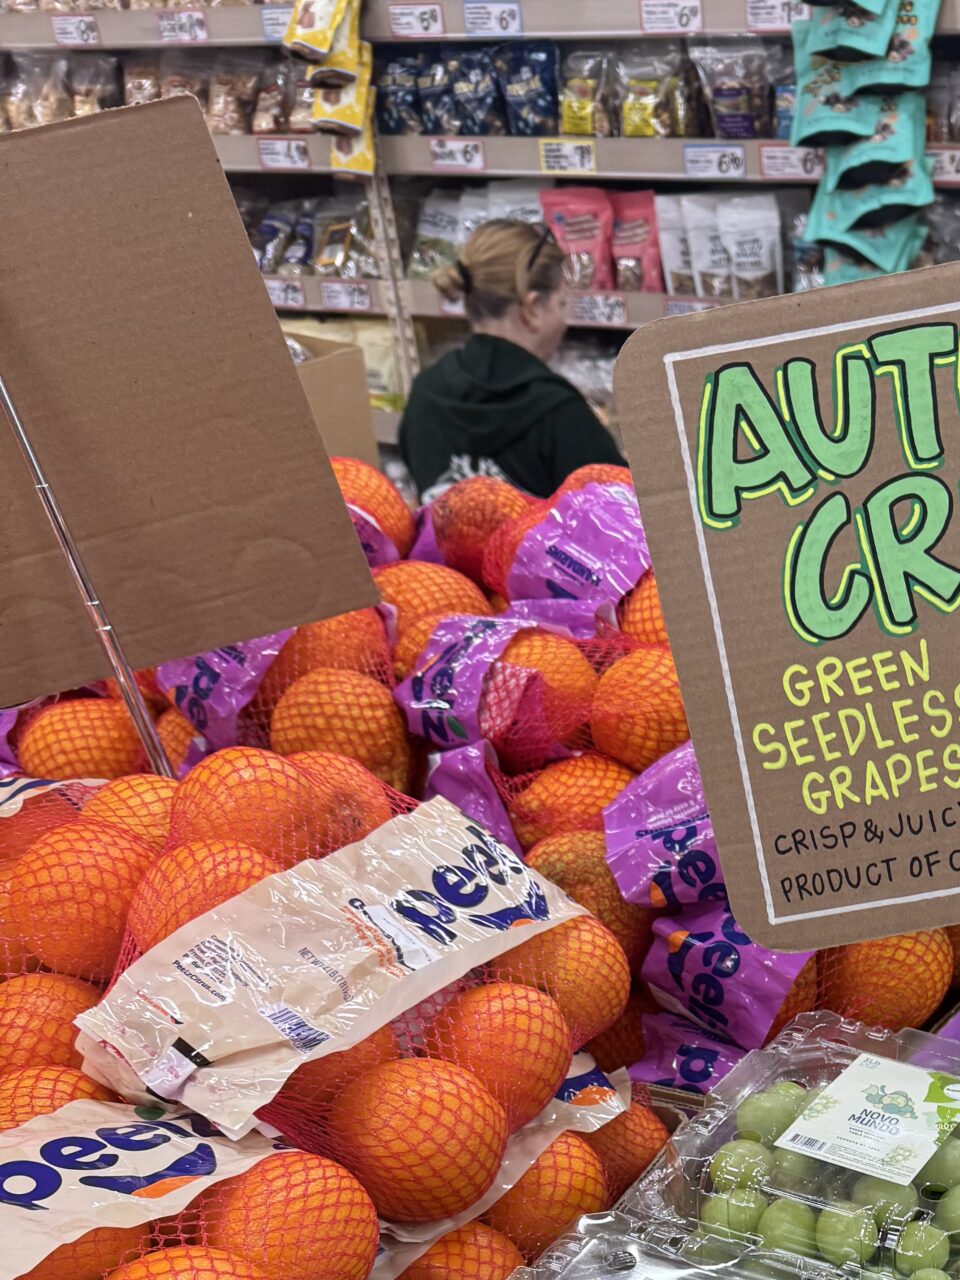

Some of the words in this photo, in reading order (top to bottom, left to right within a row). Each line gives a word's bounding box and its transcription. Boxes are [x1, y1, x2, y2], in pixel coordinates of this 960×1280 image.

[783, 639, 931, 707] GREEN
[774, 820, 857, 856] CRISP
[864, 819, 884, 844] &
[780, 857, 897, 903] PRODUCT
[909, 850, 942, 878] OF
[847, 1114, 900, 1137] MUNDO
[859, 1108, 900, 1126] NOVO
